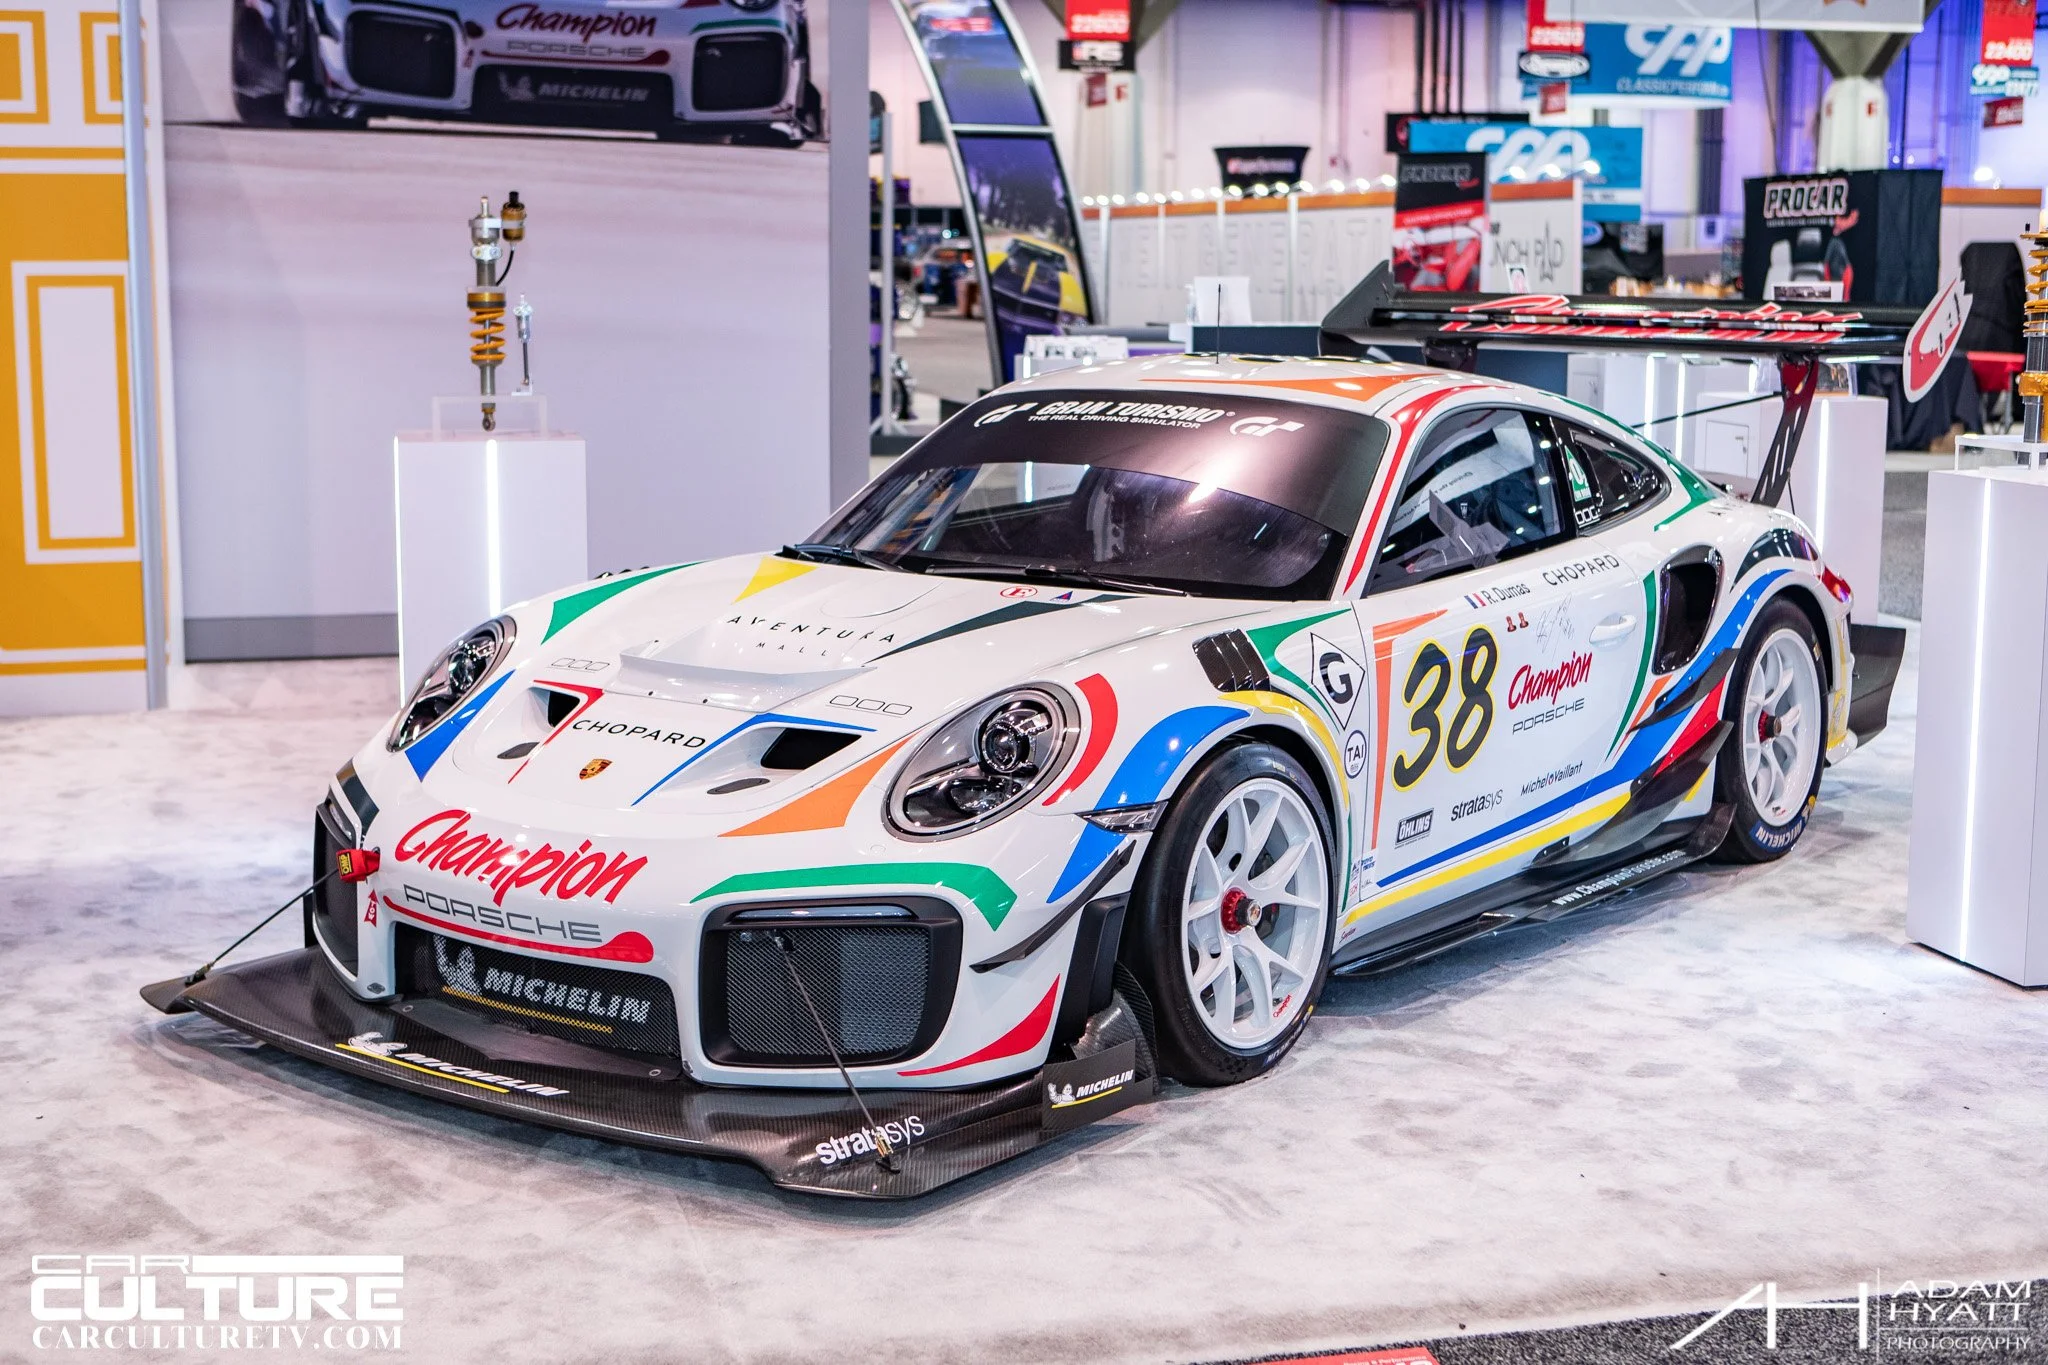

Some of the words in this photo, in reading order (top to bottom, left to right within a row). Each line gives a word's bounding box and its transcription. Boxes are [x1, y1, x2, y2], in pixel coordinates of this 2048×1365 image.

[496, 4, 657, 42] Champion
[507, 40, 645, 56] PORSCHE
[538, 83, 648, 100] MICHELIN
[1764, 177, 1849, 219] PROCAR
[1036, 401, 1114, 416] GRAN
[1082, 415, 1128, 424] DRIVING
[1130, 418, 1201, 430] SIMULATOR
[1542, 554, 1621, 587] CHOPARD
[727, 615, 896, 643] AVENTURA
[755, 642, 828, 657] MALL
[1319, 652, 1354, 705] G
[1508, 650, 1593, 710] Champion
[1392, 623, 1499, 792] 38
[1512, 698, 1585, 735] PORSCHE
[572, 719, 706, 749] CHOPARD
[1347, 744, 1364, 763] TAI
[1450, 788, 1504, 822] stratasys
[1755, 819, 1803, 849] MICHELIN
[395, 809, 649, 907] Champion
[1551, 849, 1687, 906] www.ChampionPorsche.com
[367, 900, 377, 920] TOW
[403, 884, 603, 943] PORSCHE
[483, 967, 651, 1025] MICHELIN
[395, 1053, 570, 1096] MICHELIN
[1076, 1069, 1134, 1098] MICHELIN
